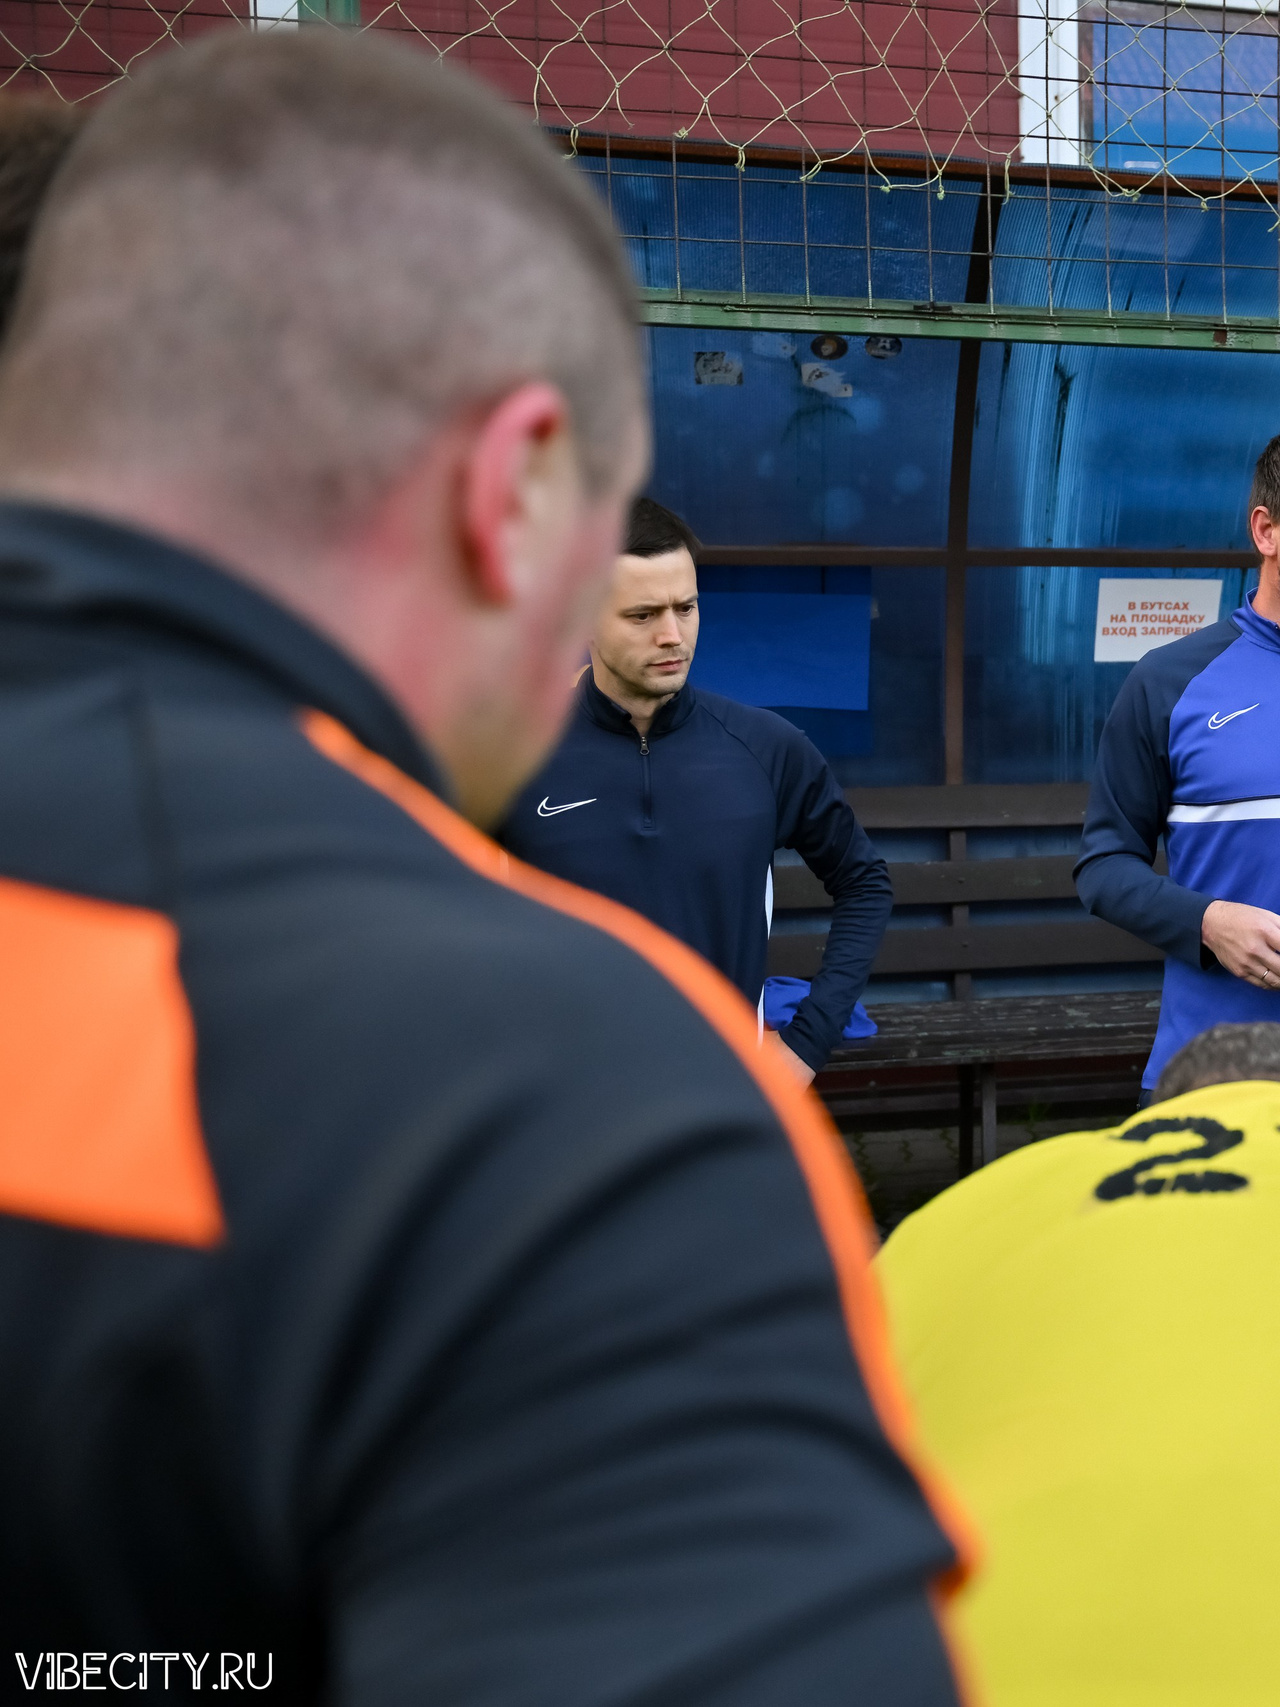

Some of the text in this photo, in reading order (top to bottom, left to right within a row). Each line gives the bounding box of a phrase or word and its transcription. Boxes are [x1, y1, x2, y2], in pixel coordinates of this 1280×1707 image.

[1128, 602, 1189, 610] В БУТСАХ
[1110, 614, 1205, 624] НА ПЛОЩАДКУ
[1102, 627, 1136, 636] ВХОД
